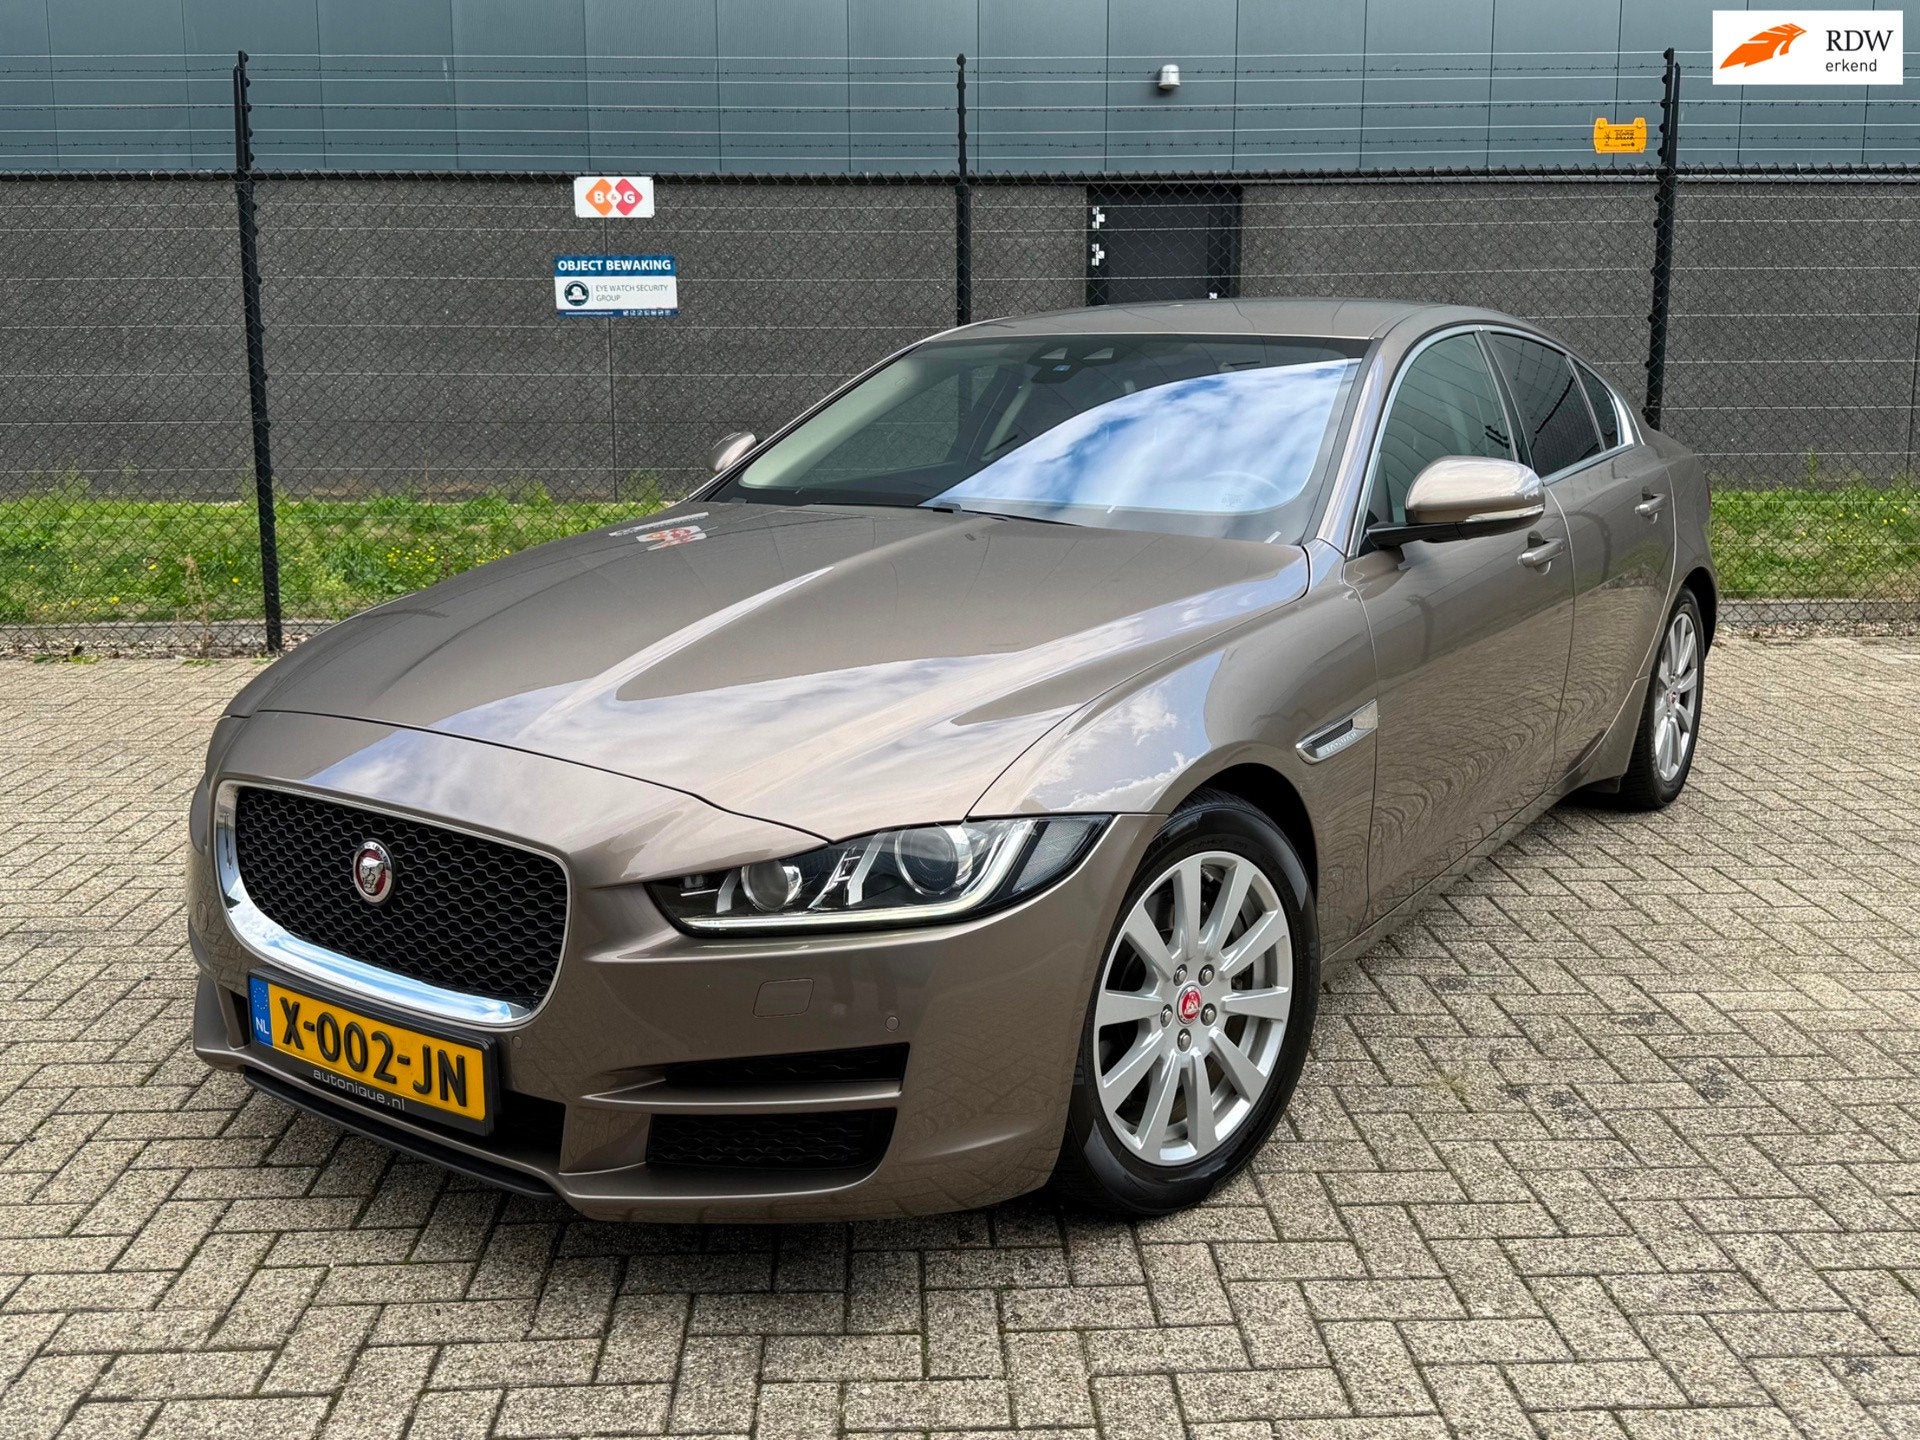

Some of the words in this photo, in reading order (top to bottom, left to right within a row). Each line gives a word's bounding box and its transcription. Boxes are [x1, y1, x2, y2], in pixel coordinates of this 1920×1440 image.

[557, 260, 603, 271] OBJECT
[605, 260, 672, 270] BEWAKING
[595, 284, 609, 292] EYE
[609, 284, 635, 292] WATCH
[635, 284, 668, 292] SECURITY
[596, 294, 621, 302] GROUP
[255, 1016, 270, 1036] NL
[279, 996, 468, 1108] X-002-JN
